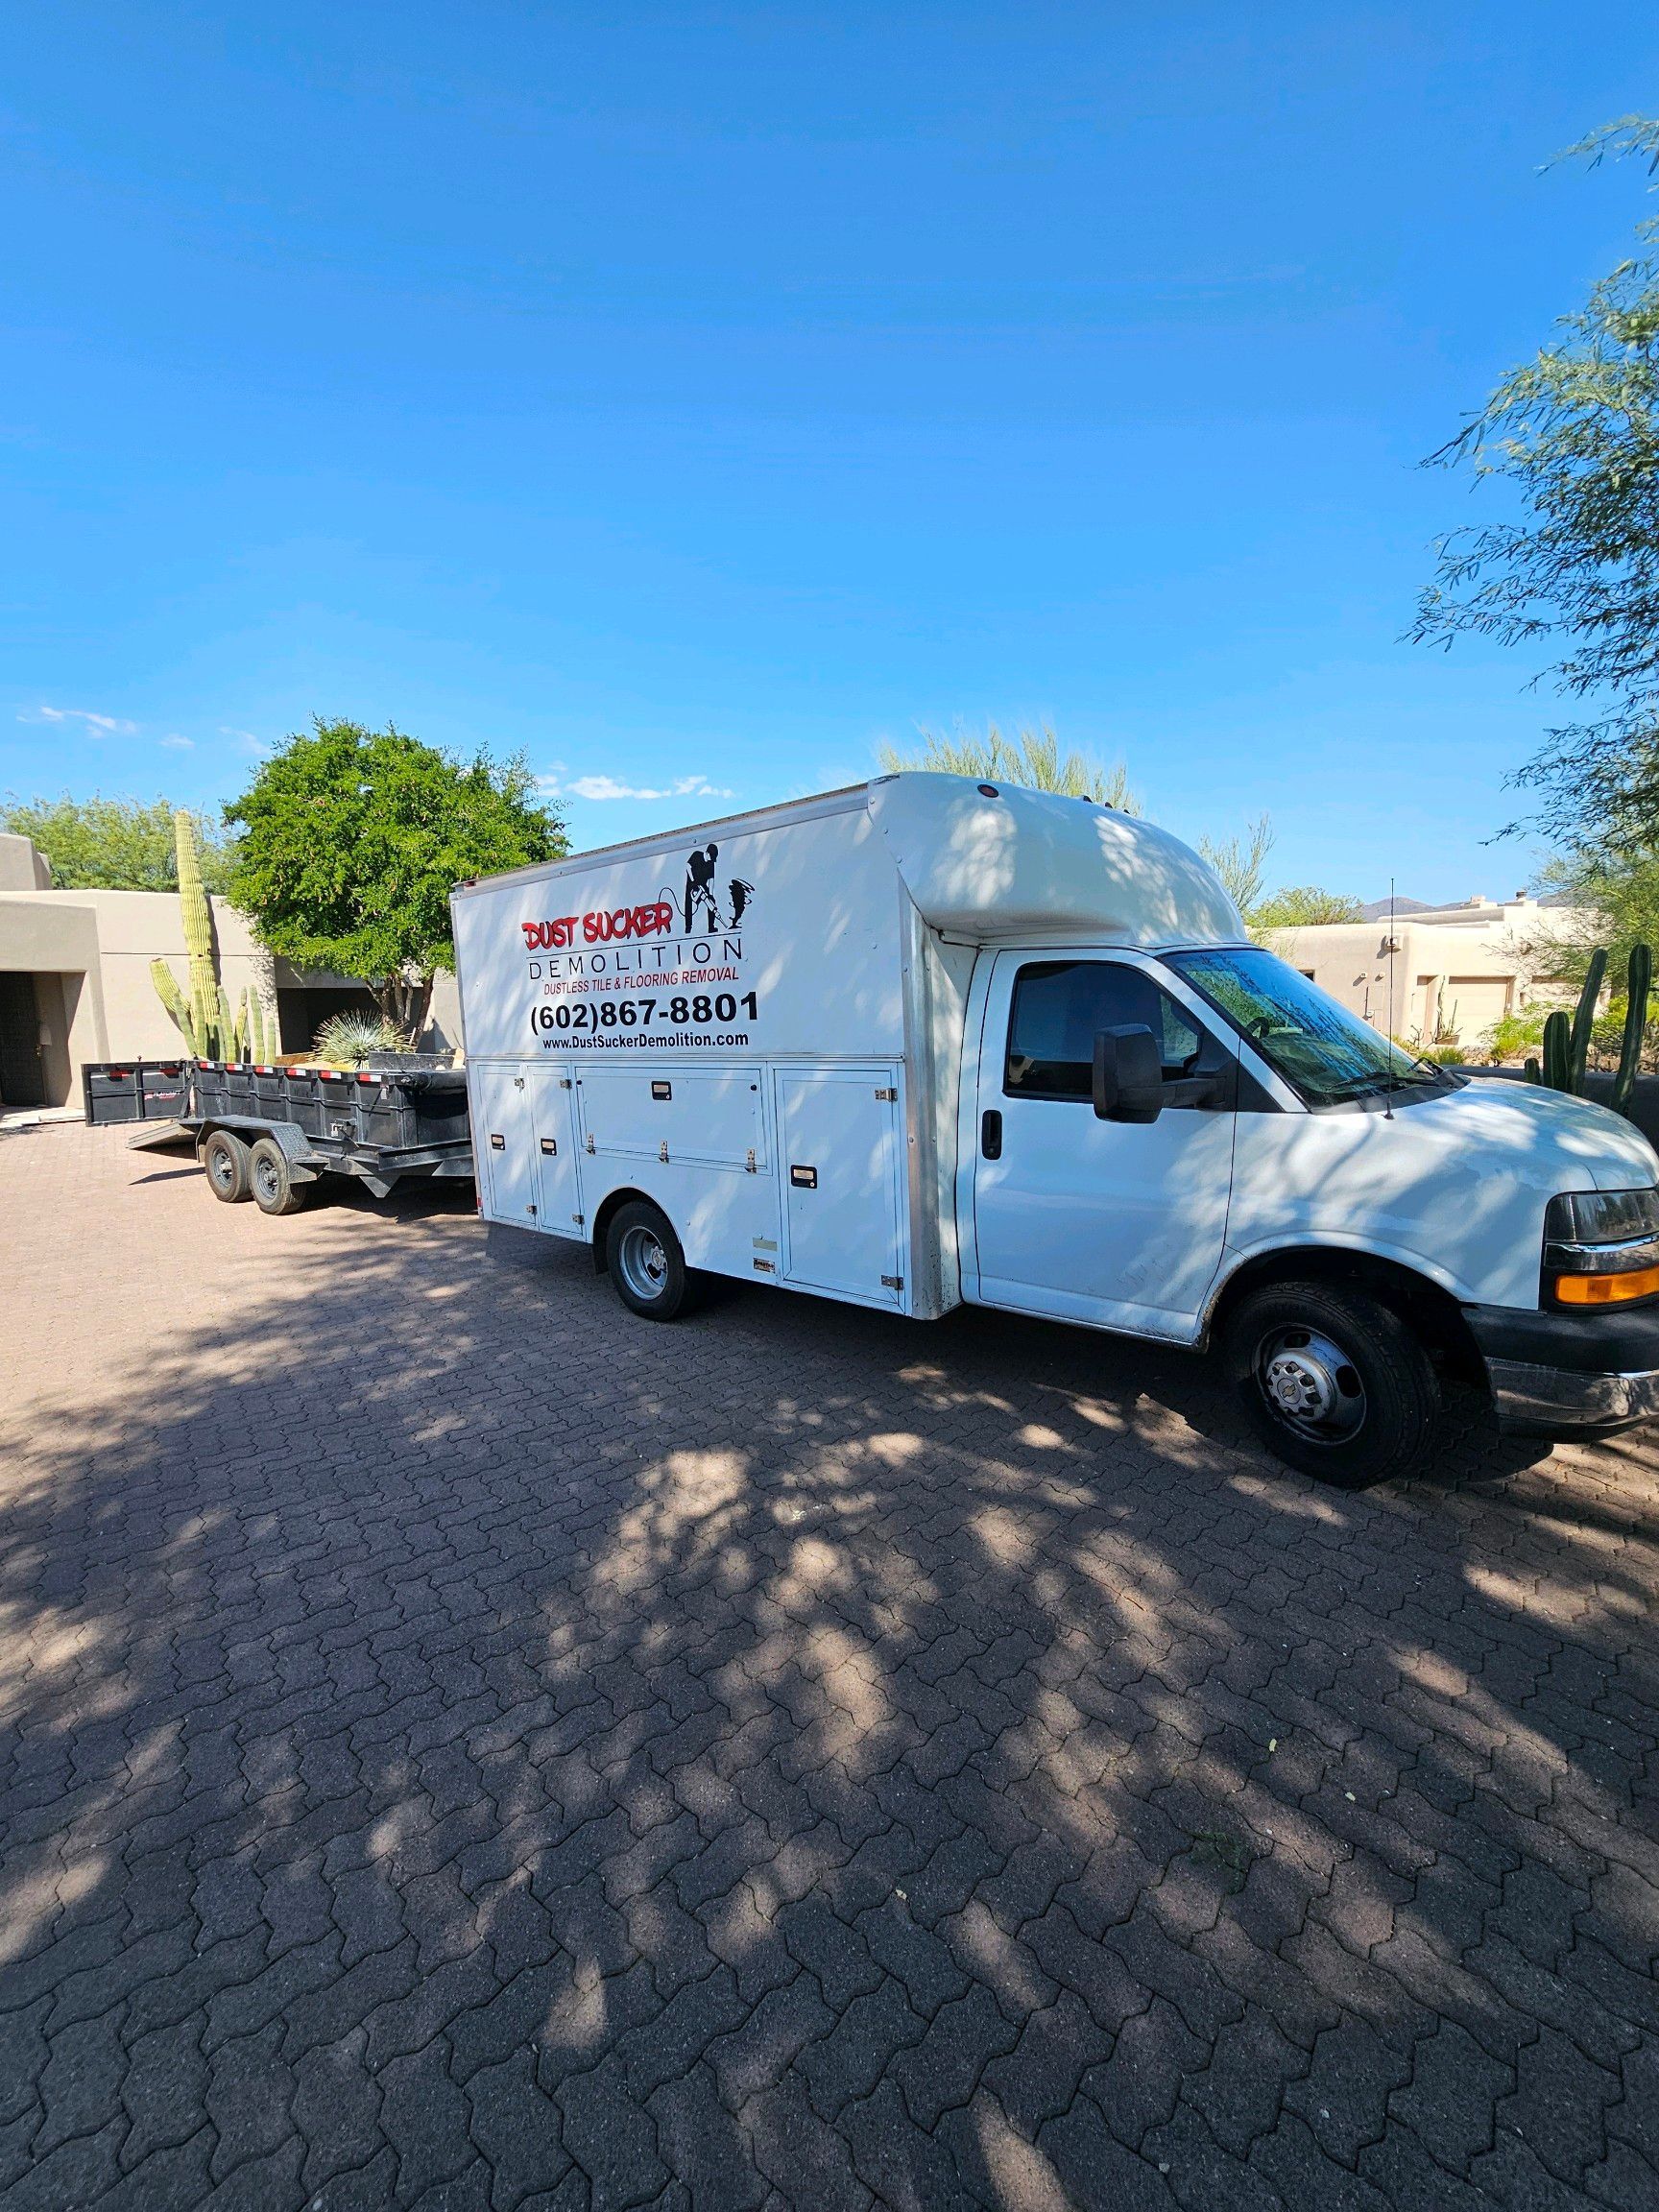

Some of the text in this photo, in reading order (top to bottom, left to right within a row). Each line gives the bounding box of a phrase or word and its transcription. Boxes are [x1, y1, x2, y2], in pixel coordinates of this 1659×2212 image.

[521, 902, 673, 950] DUST SUCKER
[529, 938, 742, 980] DEMOLITION
[544, 967, 739, 995] DUSTLESS TILE & FLOORING REMOVAL
[531, 992, 757, 1035] (602)867-8801
[542, 1032, 749, 1049] www.DustSuckerDemolition.com
